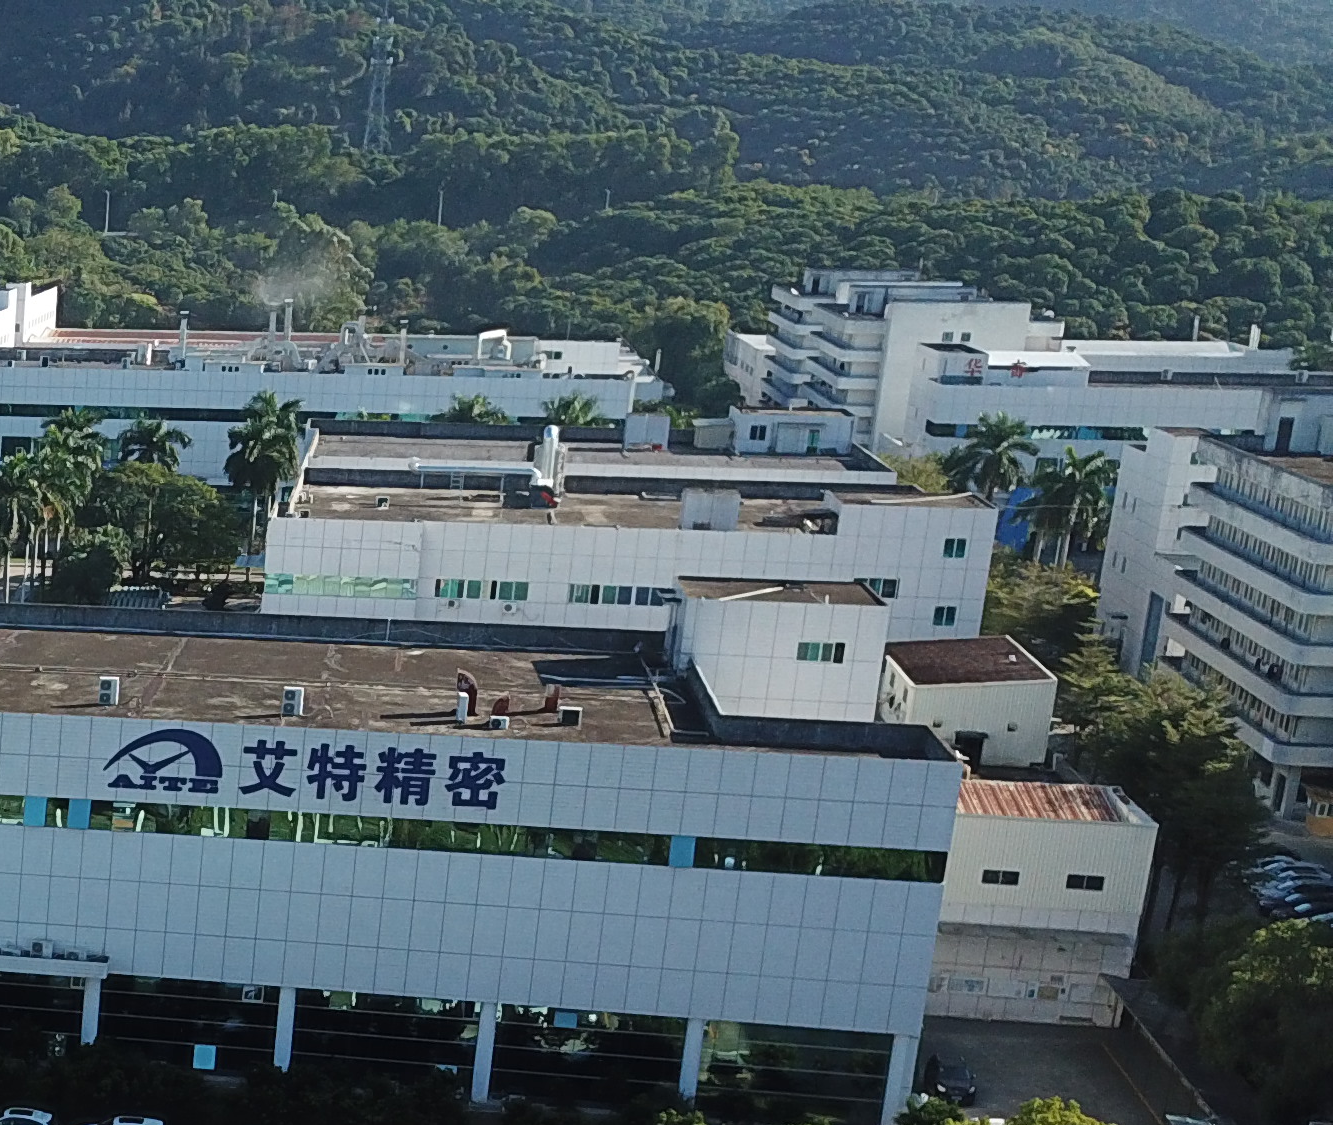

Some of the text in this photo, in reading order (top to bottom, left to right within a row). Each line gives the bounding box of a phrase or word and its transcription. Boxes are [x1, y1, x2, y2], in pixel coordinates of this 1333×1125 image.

[108, 775, 219, 793] AITE
[239, 739, 507, 809] 艾特精密
